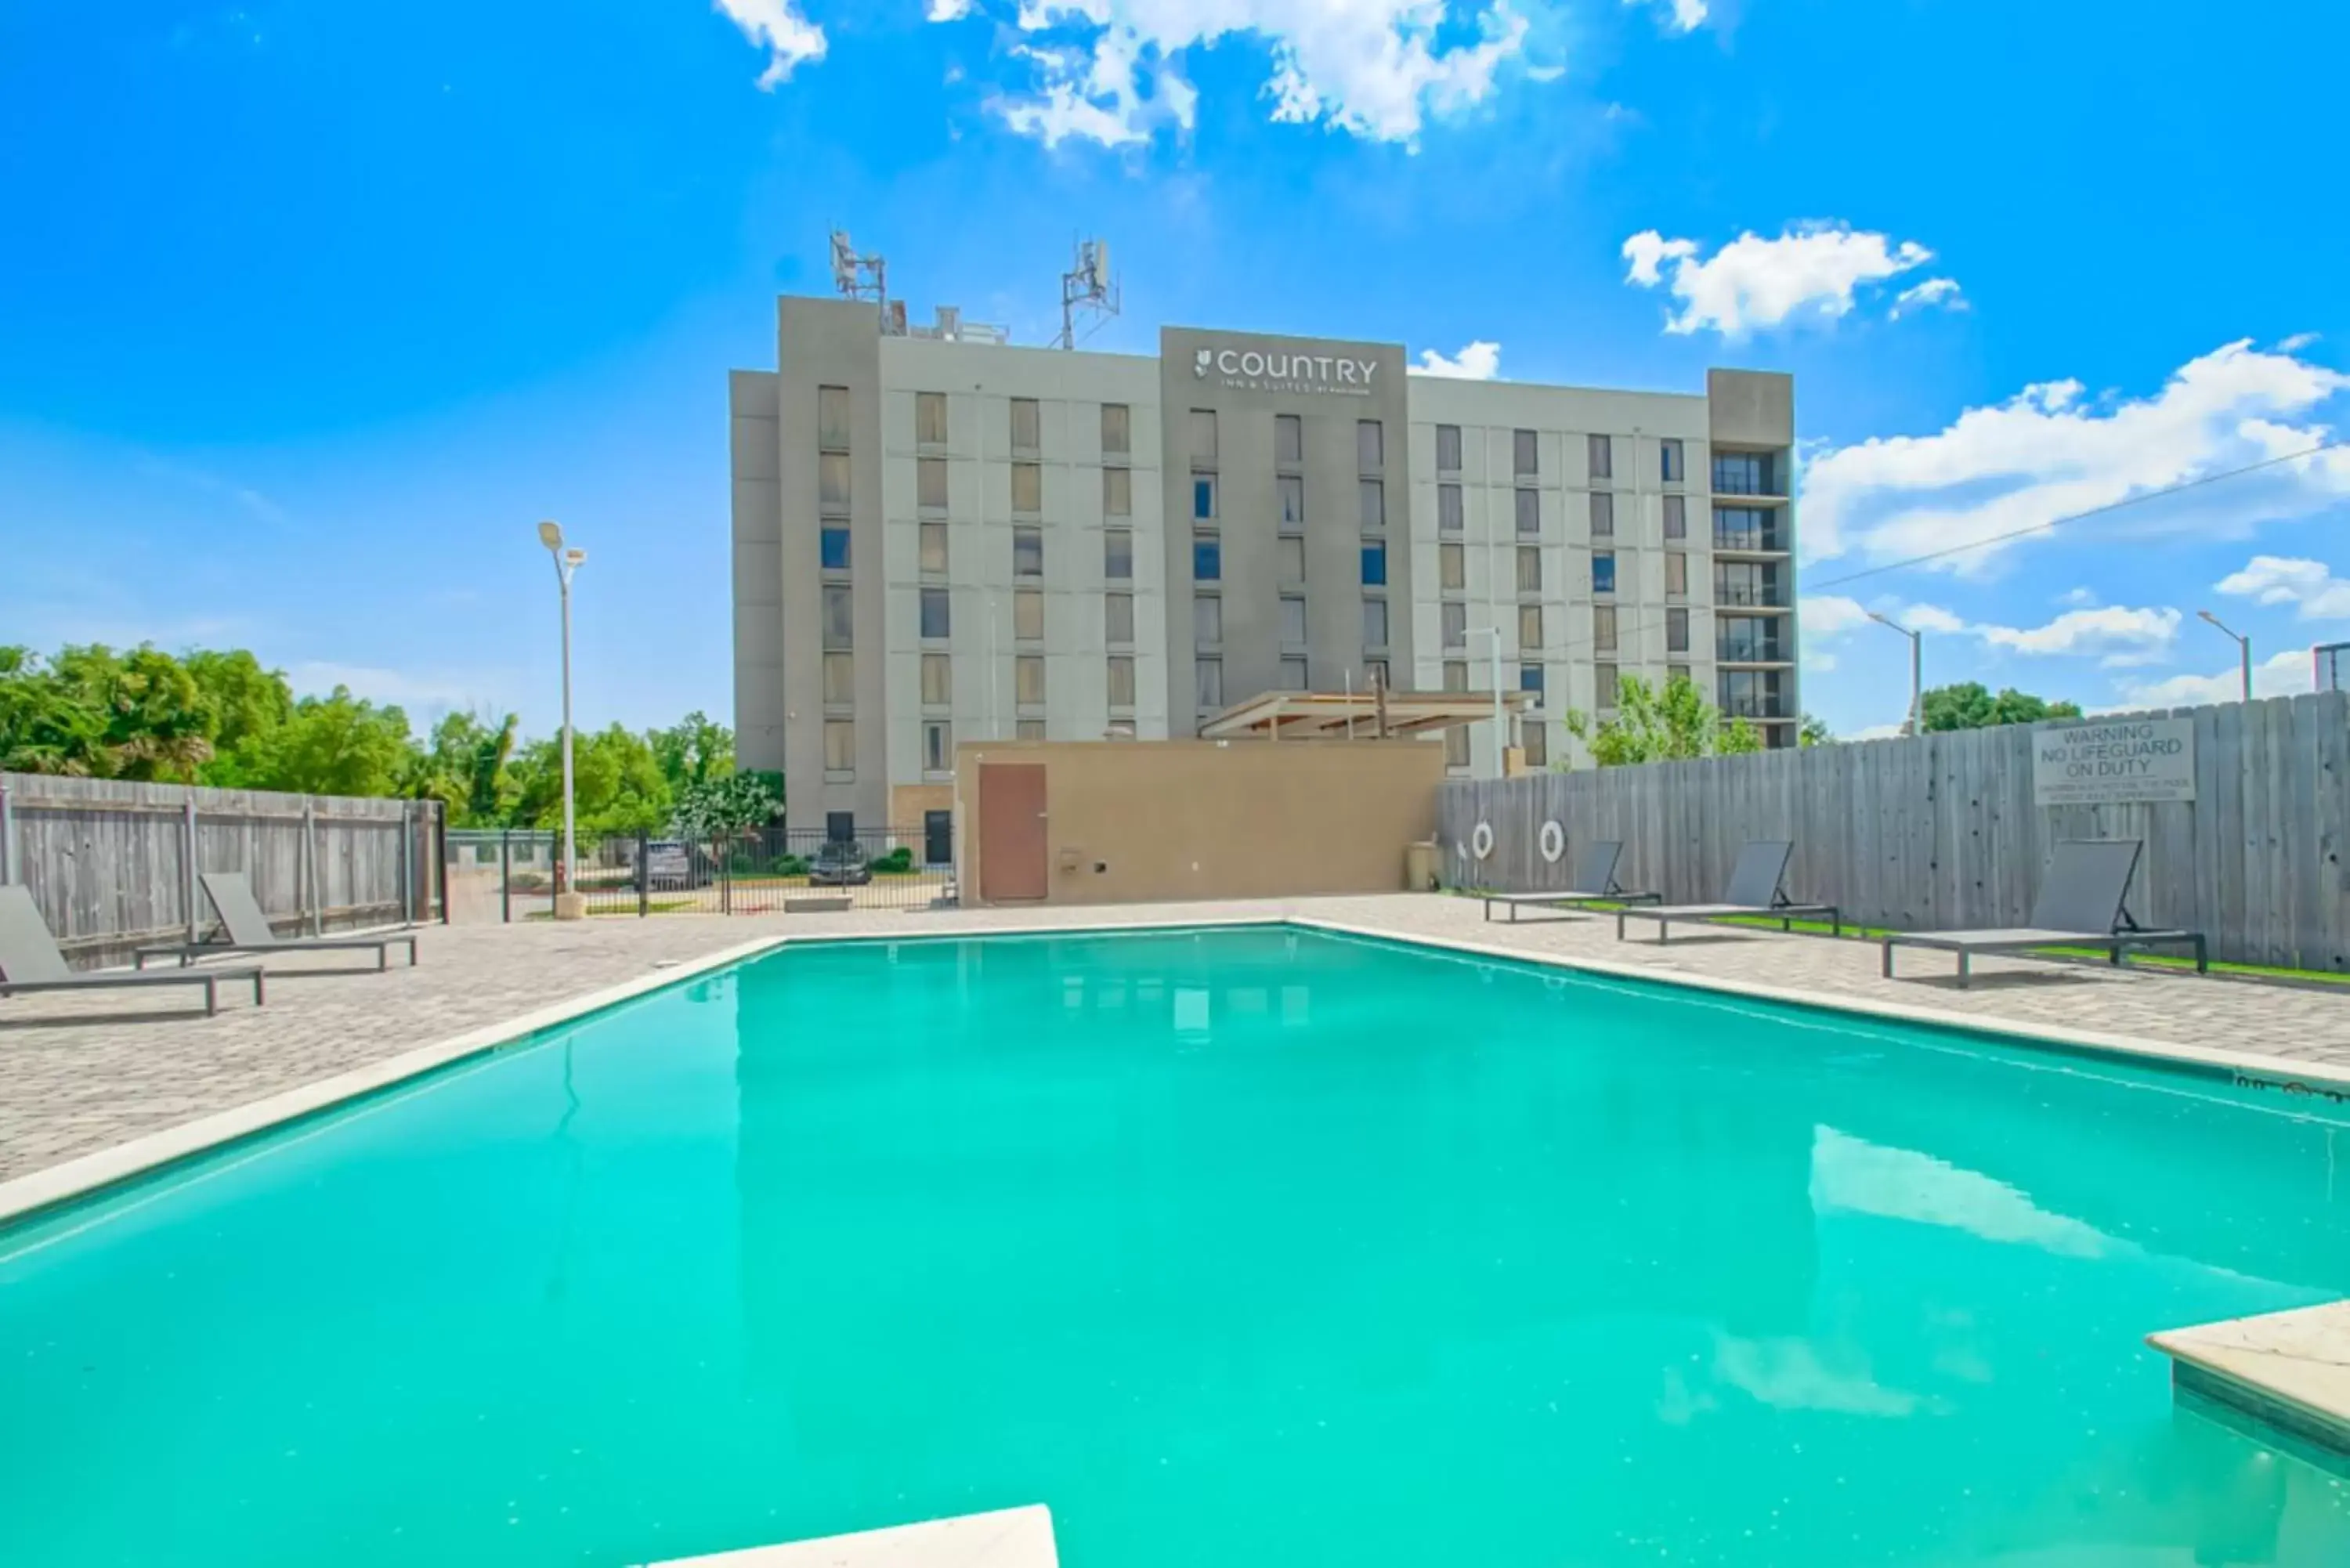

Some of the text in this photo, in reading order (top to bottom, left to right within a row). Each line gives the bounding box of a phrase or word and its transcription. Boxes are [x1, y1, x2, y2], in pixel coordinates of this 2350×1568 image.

[2063, 724, 2154, 744] WARNING
[2041, 738, 2182, 764] NO LIFEGUARD
[2066, 758, 2153, 778] ON DUTY
